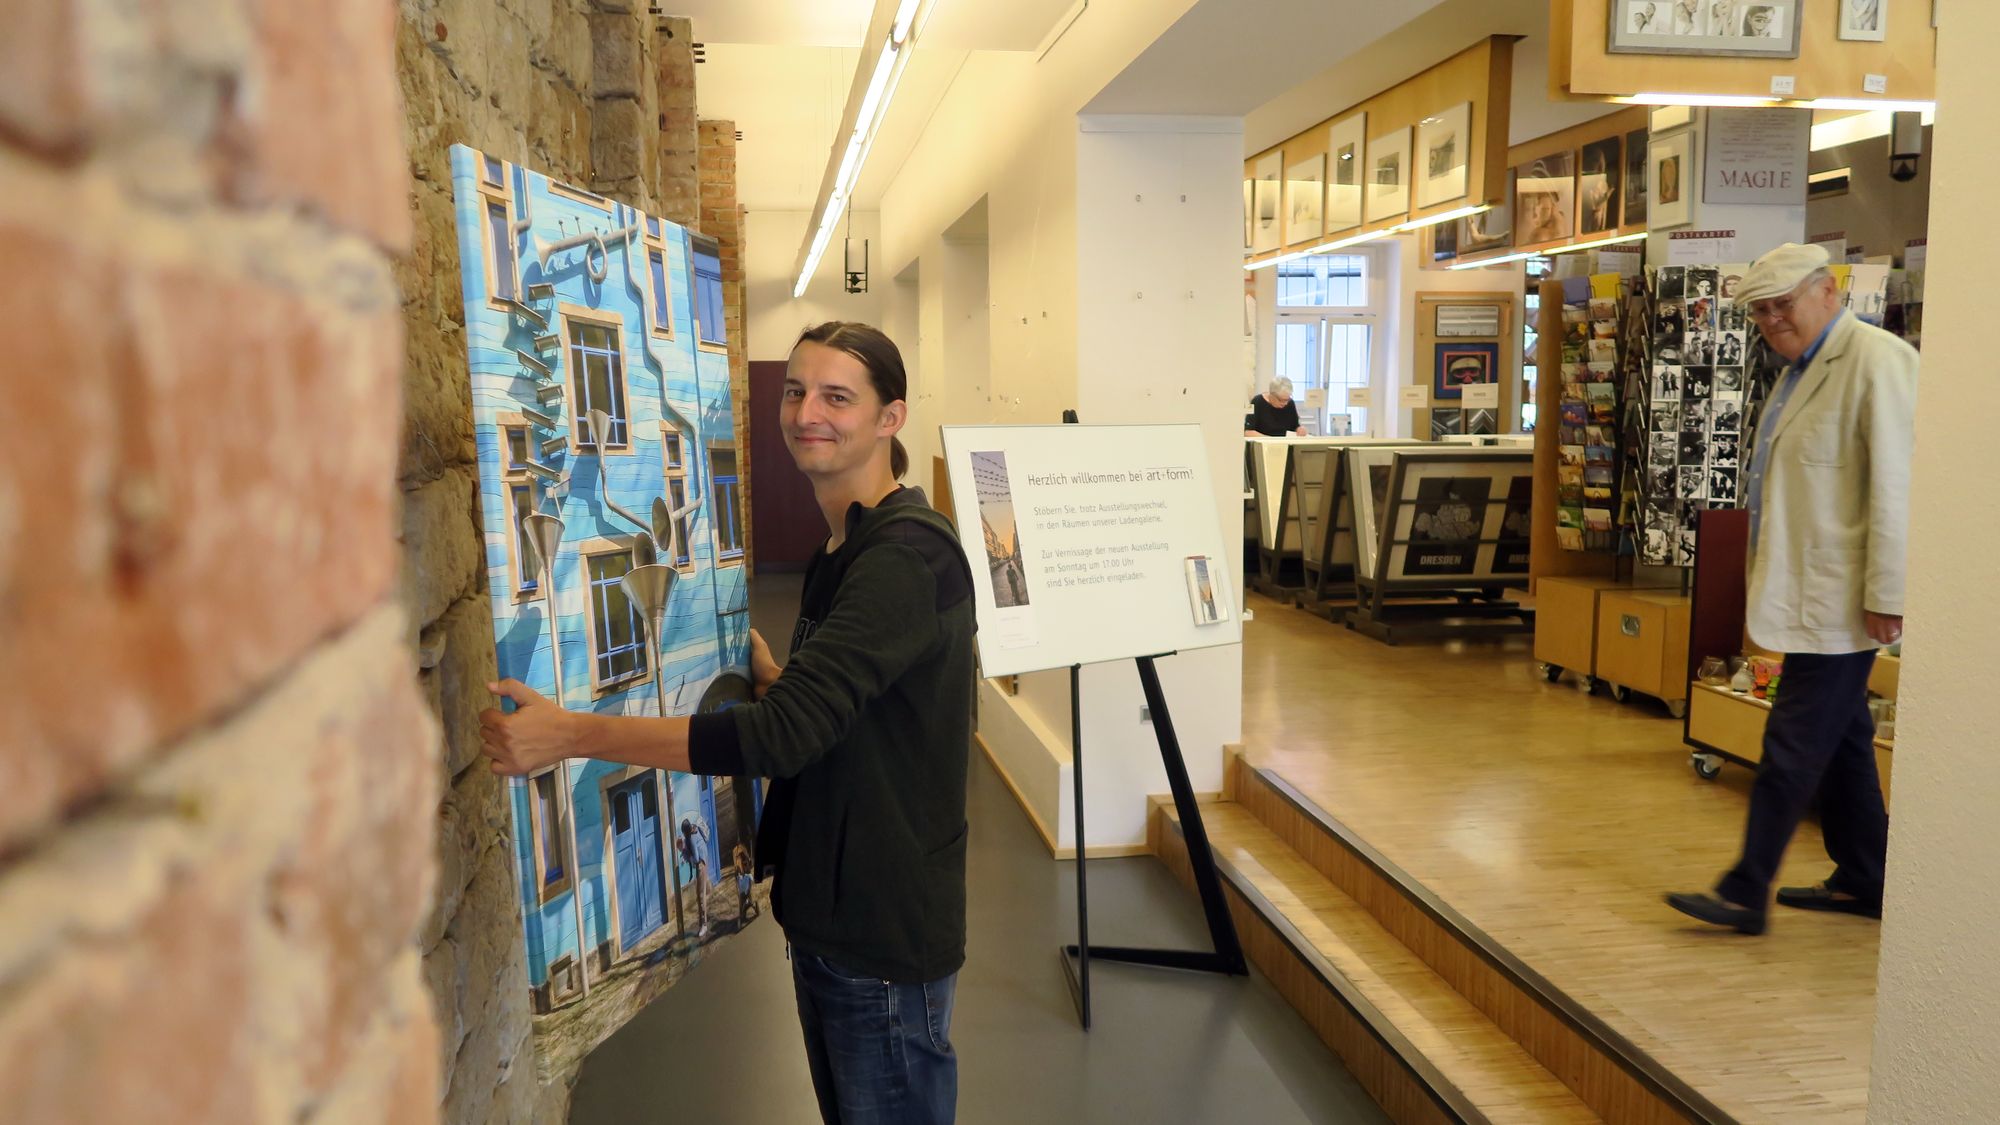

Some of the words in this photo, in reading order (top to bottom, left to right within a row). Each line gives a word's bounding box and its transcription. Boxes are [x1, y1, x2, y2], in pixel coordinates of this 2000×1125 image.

[1719, 169, 1792, 189] MAGIE
[1028, 473, 1067, 486] Herzlich
[1071, 472, 1126, 485] willkommen
[1128, 470, 1143, 482] bei
[1036, 521, 1044, 530] in
[1046, 520, 1060, 530] den
[1092, 517, 1118, 527] unserer
[1041, 549, 1053, 559] Zur
[1055, 547, 1092, 557] Vernissage
[1095, 546, 1106, 555] der
[1108, 545, 1129, 553] neuen
[1131, 541, 1169, 552] Ausstellung
[1044, 565, 1055, 573] am
[1057, 562, 1087, 572] Sonntag
[1089, 562, 1100, 570] um
[1122, 558, 1134, 567] Uhr
[1420, 555, 1462, 565] DRESDEN
[1046, 578, 1062, 588] sind
[1064, 577, 1075, 586] Sie
[1077, 575, 1105, 585] herzlich
